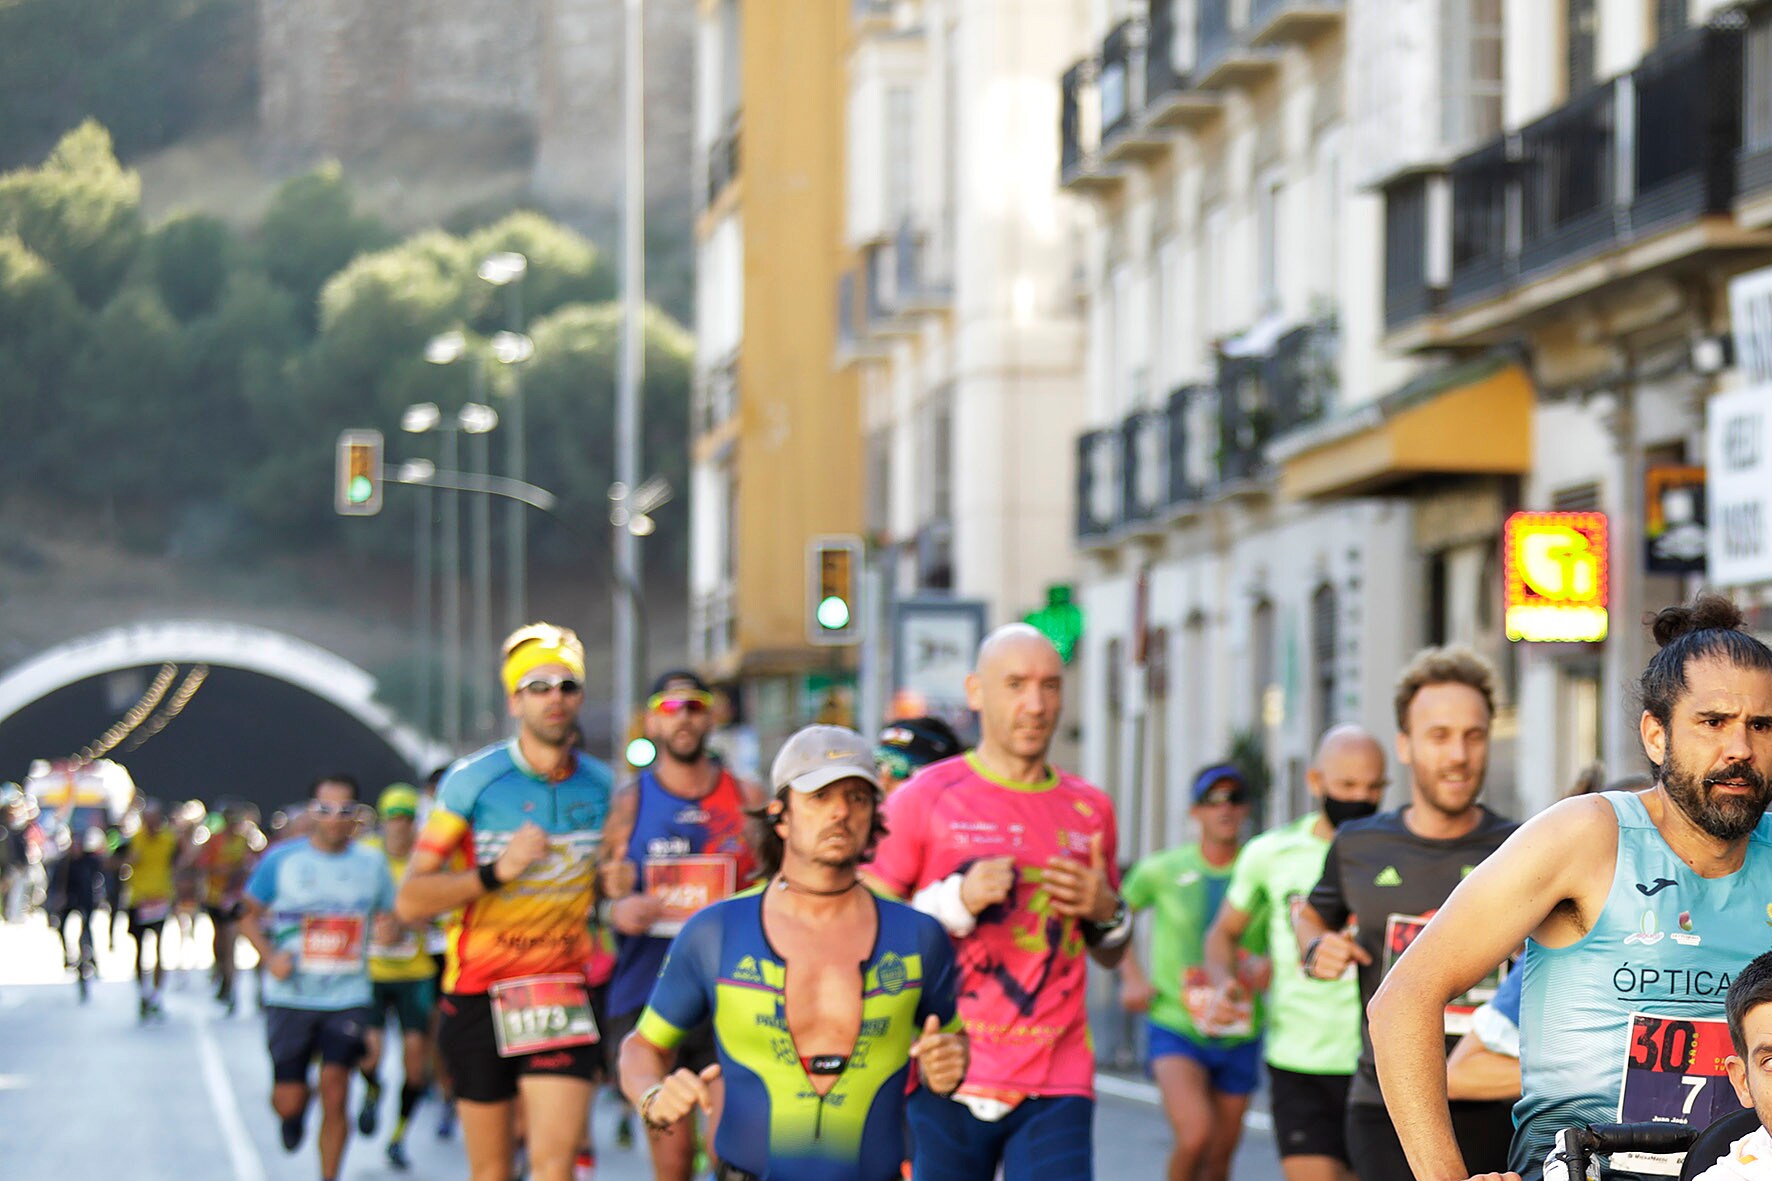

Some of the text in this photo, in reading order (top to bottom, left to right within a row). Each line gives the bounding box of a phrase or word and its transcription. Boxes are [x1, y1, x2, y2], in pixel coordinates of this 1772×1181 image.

[1613, 962, 1732, 996] ÓPTICA
[507, 1004, 569, 1034] 1173
[1628, 1016, 1697, 1074] 30
[1680, 1075, 1708, 1115] 7
[1652, 1115, 1670, 1123] Juan
